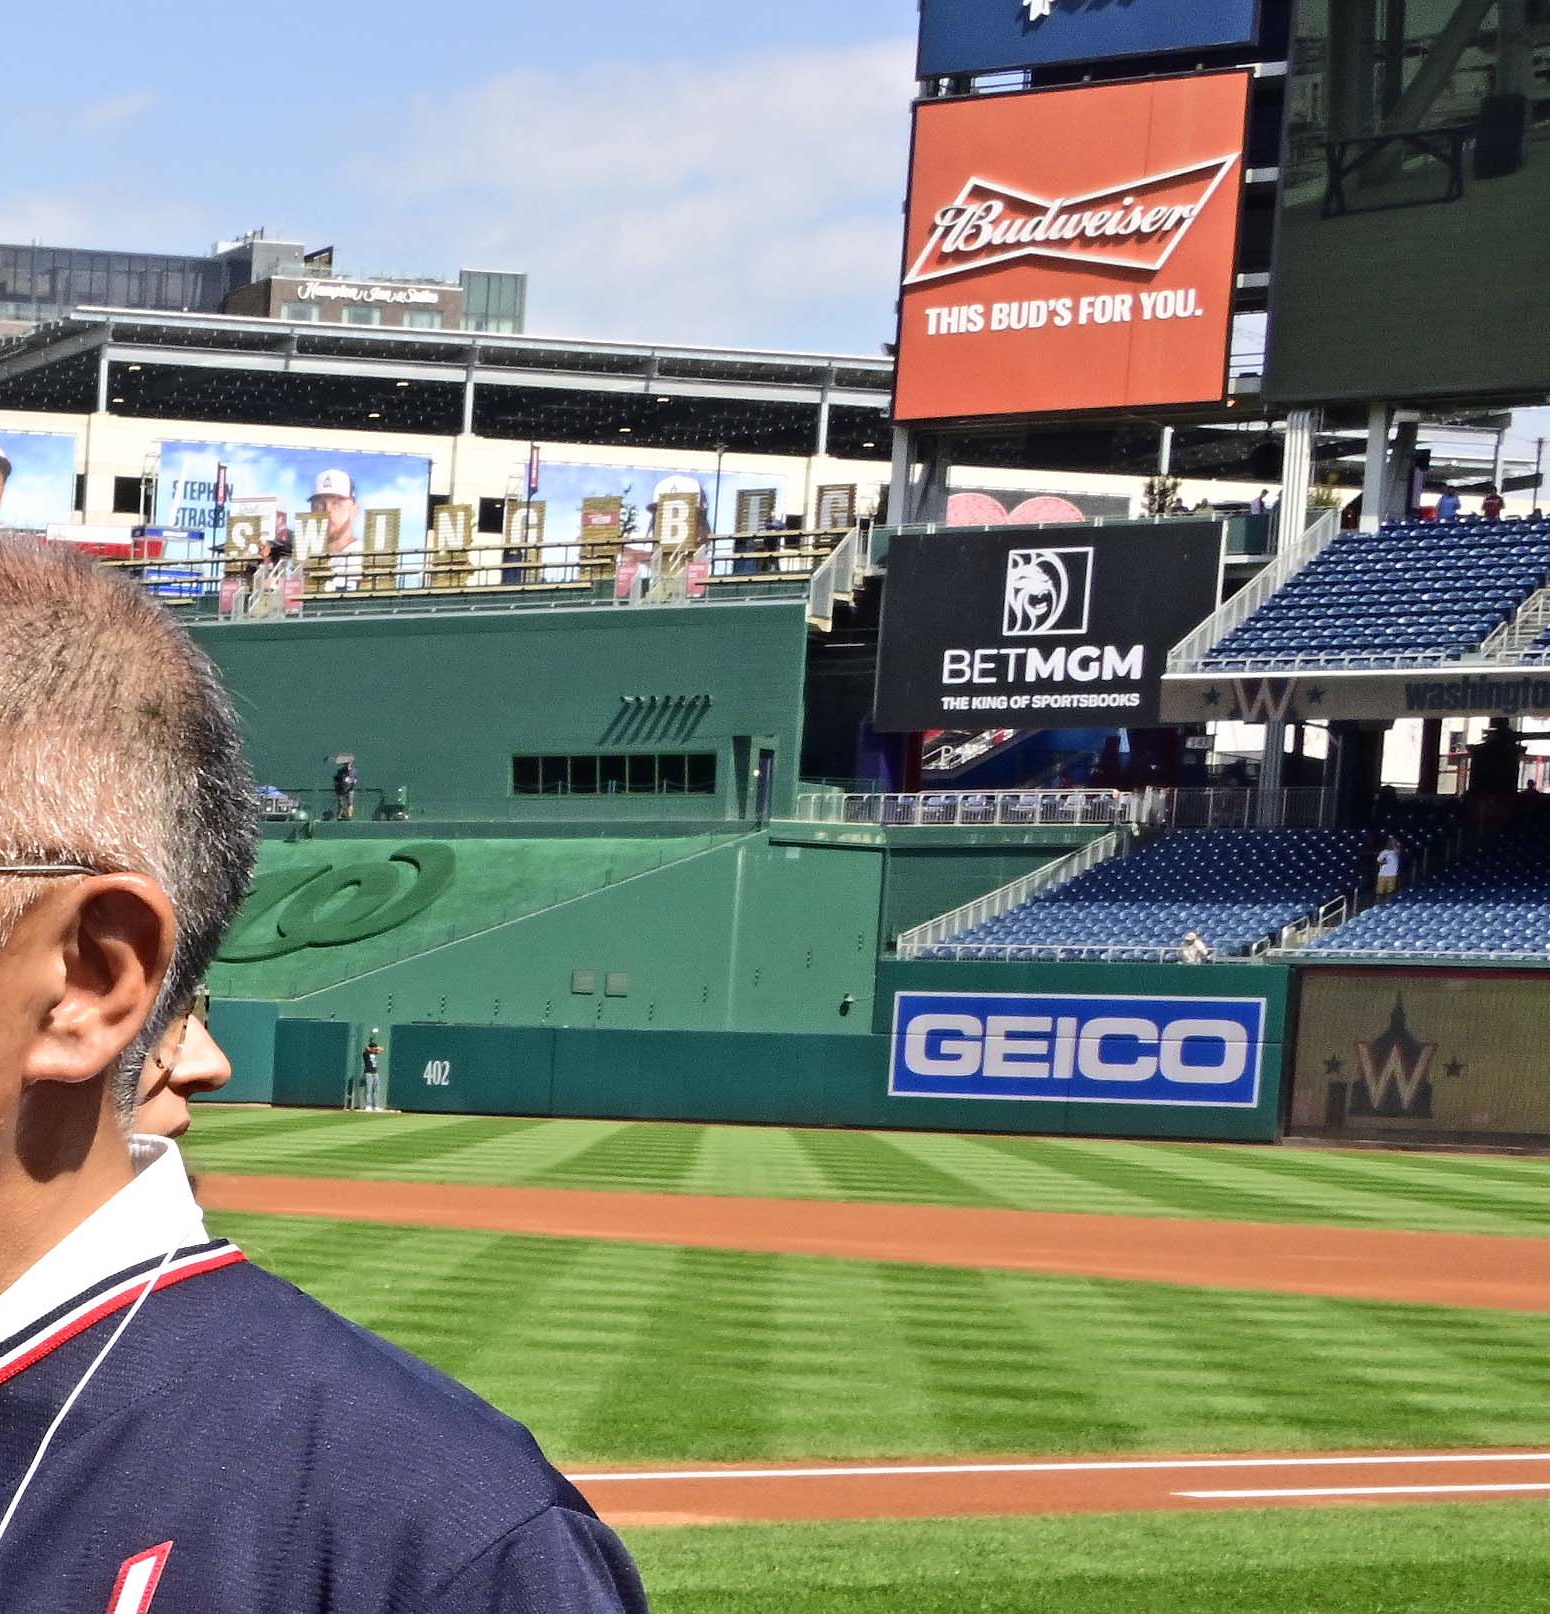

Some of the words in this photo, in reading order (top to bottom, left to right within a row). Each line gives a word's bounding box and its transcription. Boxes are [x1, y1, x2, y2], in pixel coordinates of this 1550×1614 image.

[935, 197, 1198, 252] Budweiser
[925, 305, 984, 335] THIS
[991, 298, 1072, 330] BUD'S
[1079, 294, 1133, 325] FOR
[1141, 288, 1203, 319] YOU.
[172, 480, 233, 502] TEPHN
[942, 644, 1144, 684] BETMGM
[941, 696, 969, 711] THE
[971, 695, 1008, 710] KING
[1010, 695, 1030, 709] OF
[1031, 693, 1141, 709] SPORTSBOOKS
[903, 1013, 1247, 1085] GEICO
[423, 1060, 451, 1086] 402
